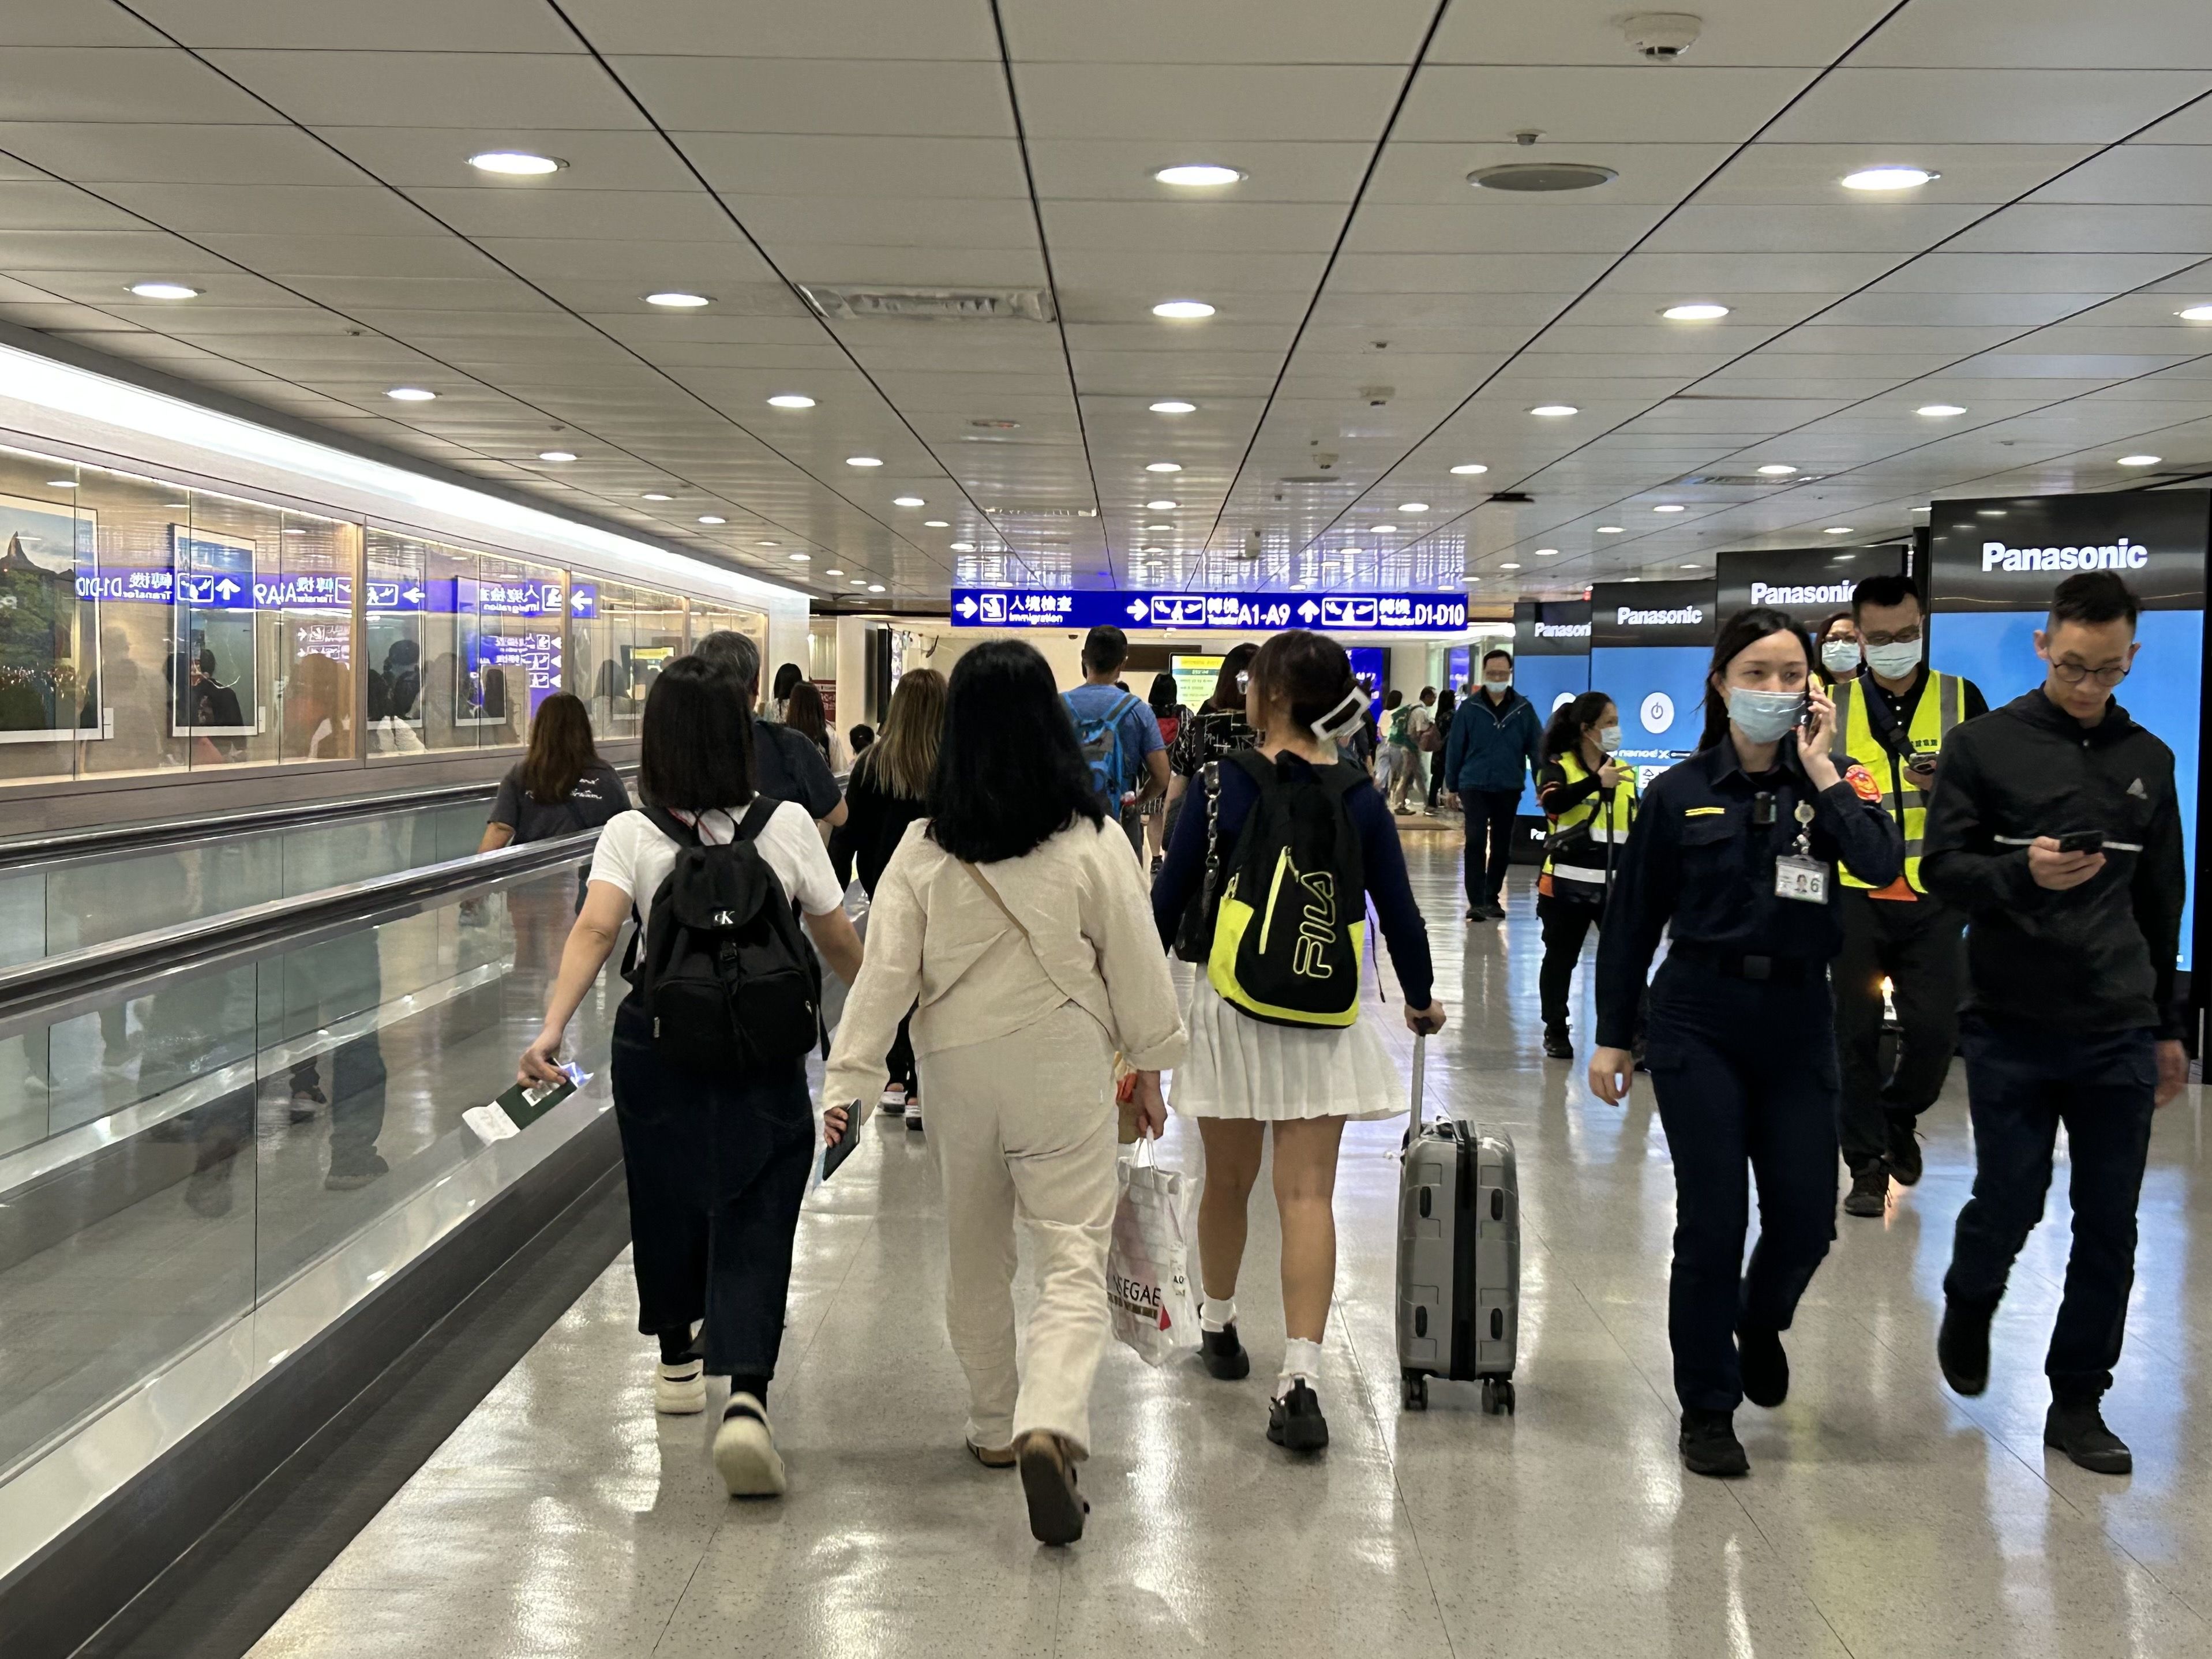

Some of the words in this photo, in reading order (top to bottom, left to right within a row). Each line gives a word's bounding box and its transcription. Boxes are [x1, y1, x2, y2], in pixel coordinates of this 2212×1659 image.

[1982, 538, 2148, 572] Panasonic
[1008, 611, 1063, 625] Immigration
[1238, 603, 1291, 626] A1-A9
[1414, 603, 1465, 626] D1-D10
[1617, 605, 1703, 625] Panasonic
[1535, 621, 1592, 637] Panasoni
[1293, 871, 1336, 979] FILA
